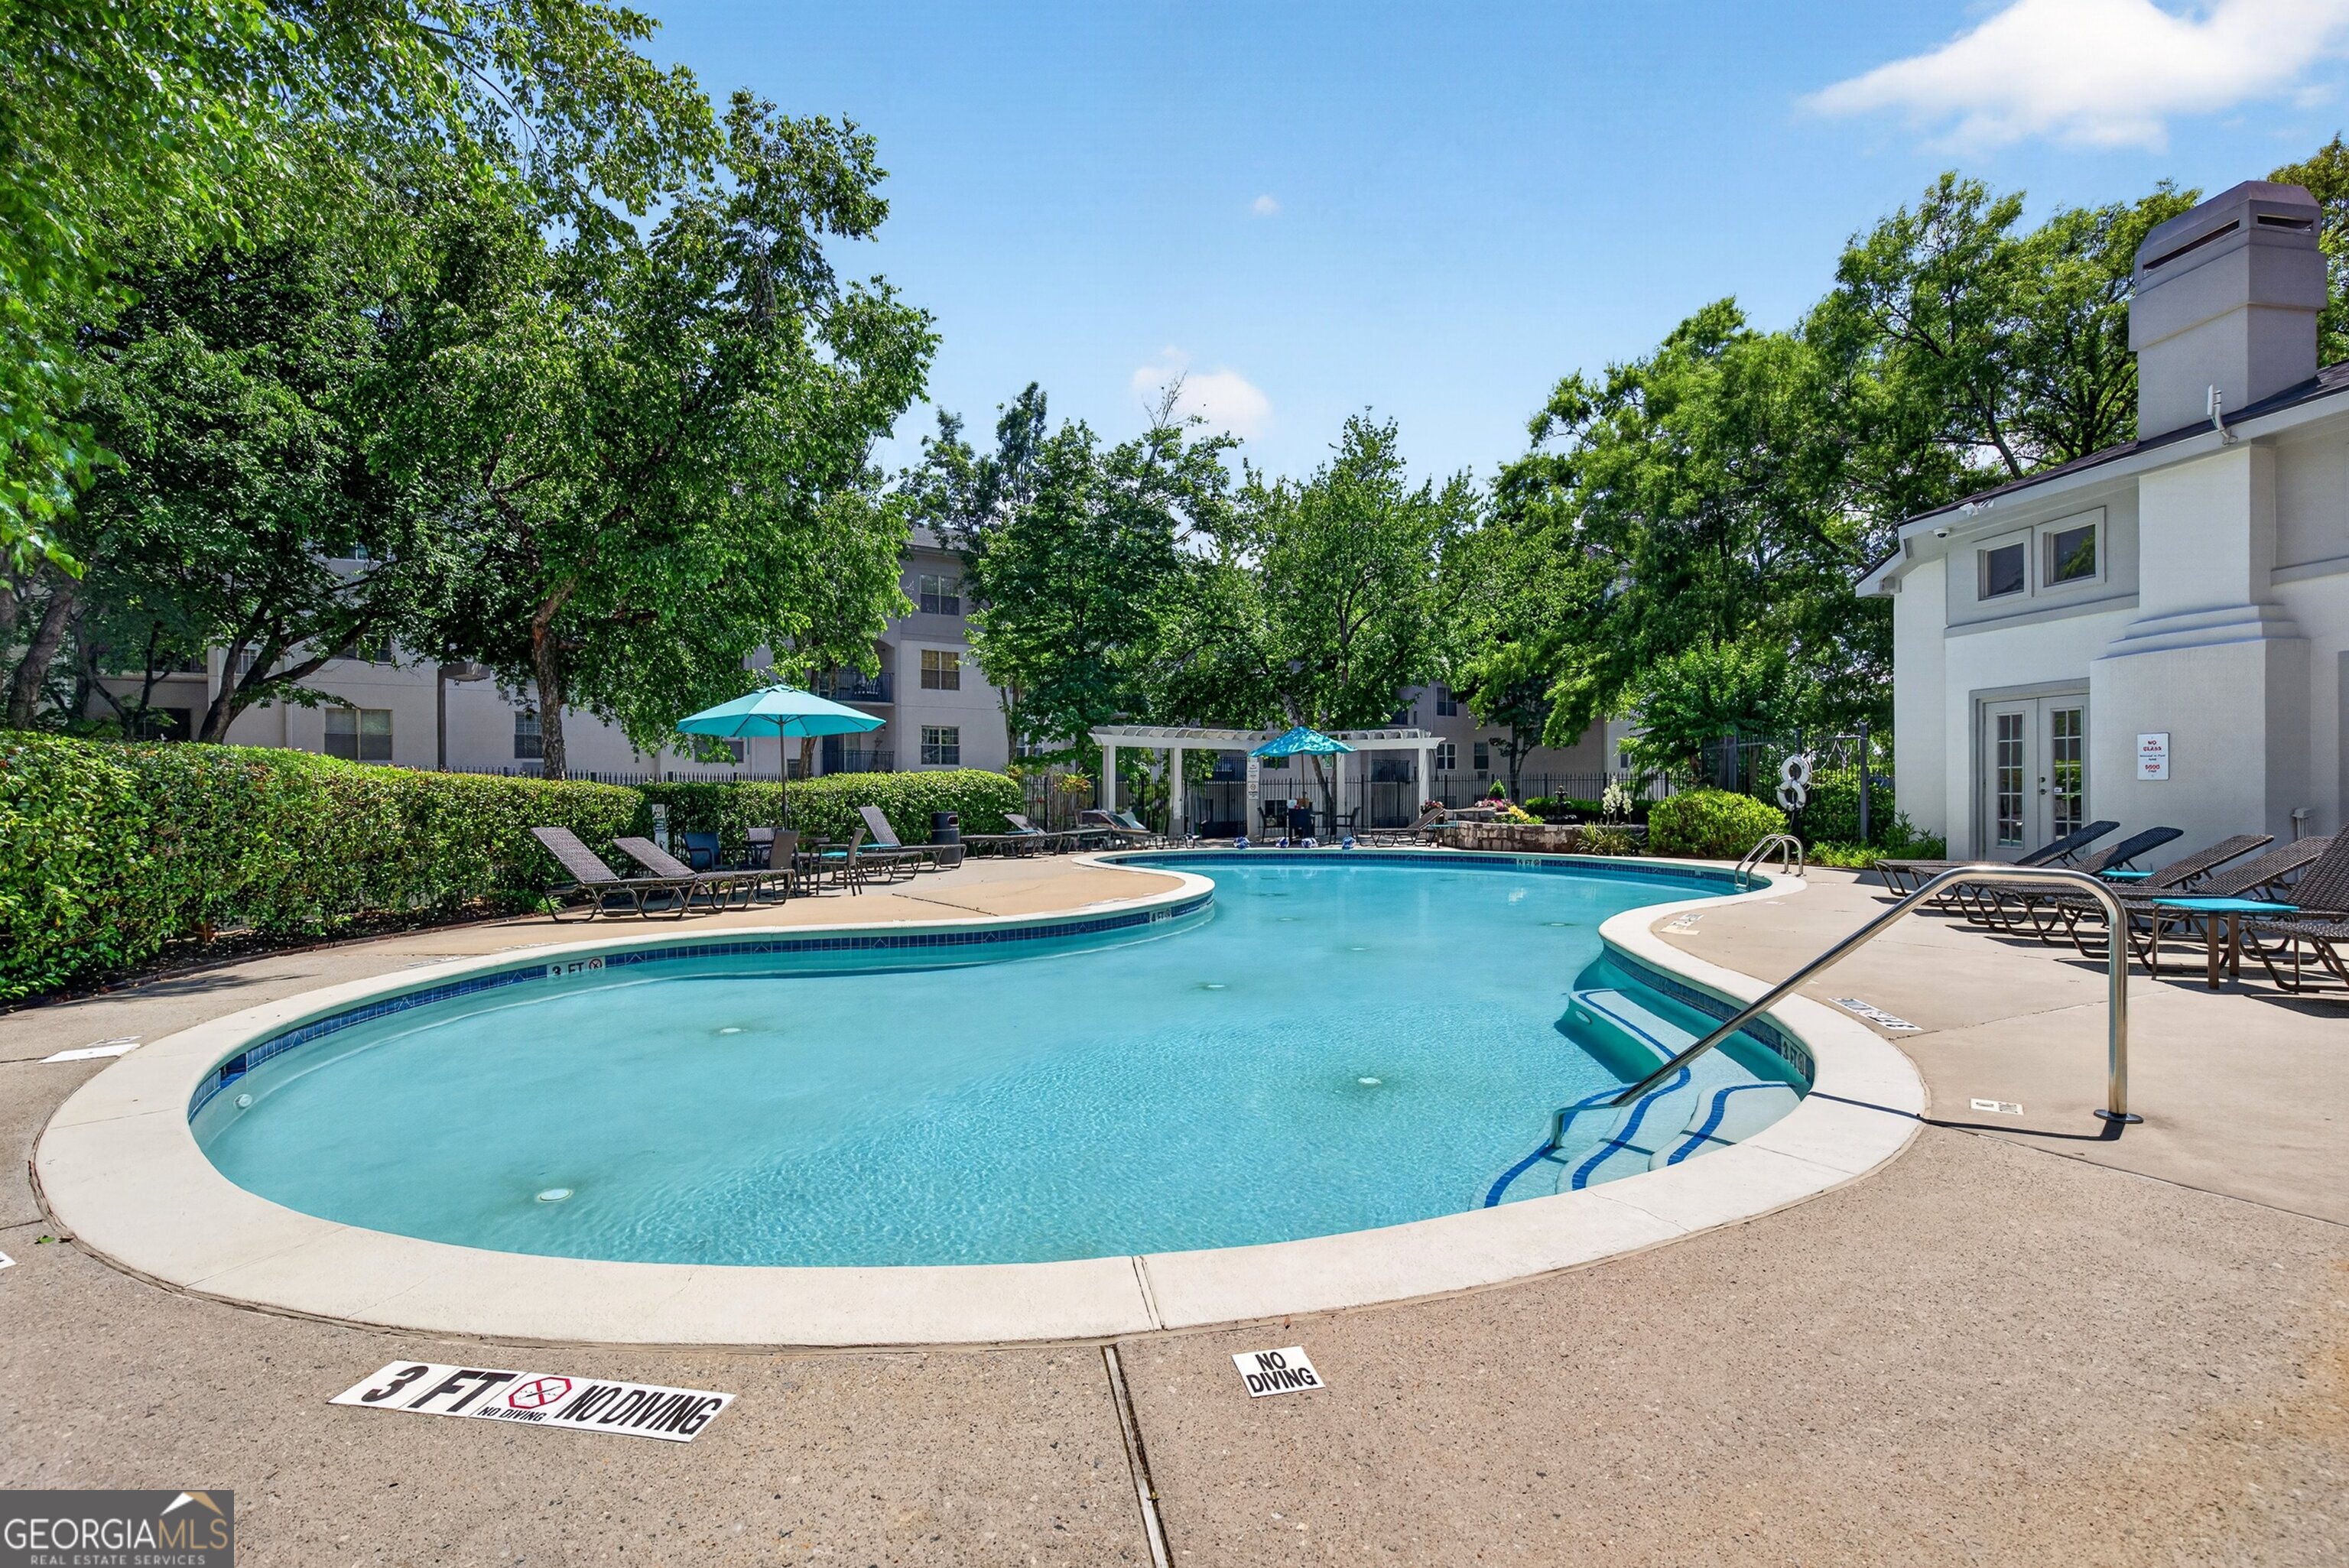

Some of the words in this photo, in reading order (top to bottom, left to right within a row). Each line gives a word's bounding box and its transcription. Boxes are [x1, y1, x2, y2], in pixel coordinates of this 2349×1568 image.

[568, 962, 584, 973] FT
[1255, 1352, 1286, 1372] NO
[361, 1365, 429, 1402] 3
[407, 1369, 518, 1412] FT
[1246, 1368, 1318, 1393] DIVING
[476, 1406, 502, 1417] NO
[499, 1408, 547, 1421] DIVING
[554, 1385, 622, 1422] NO
[596, 1389, 723, 1435] DIVING
